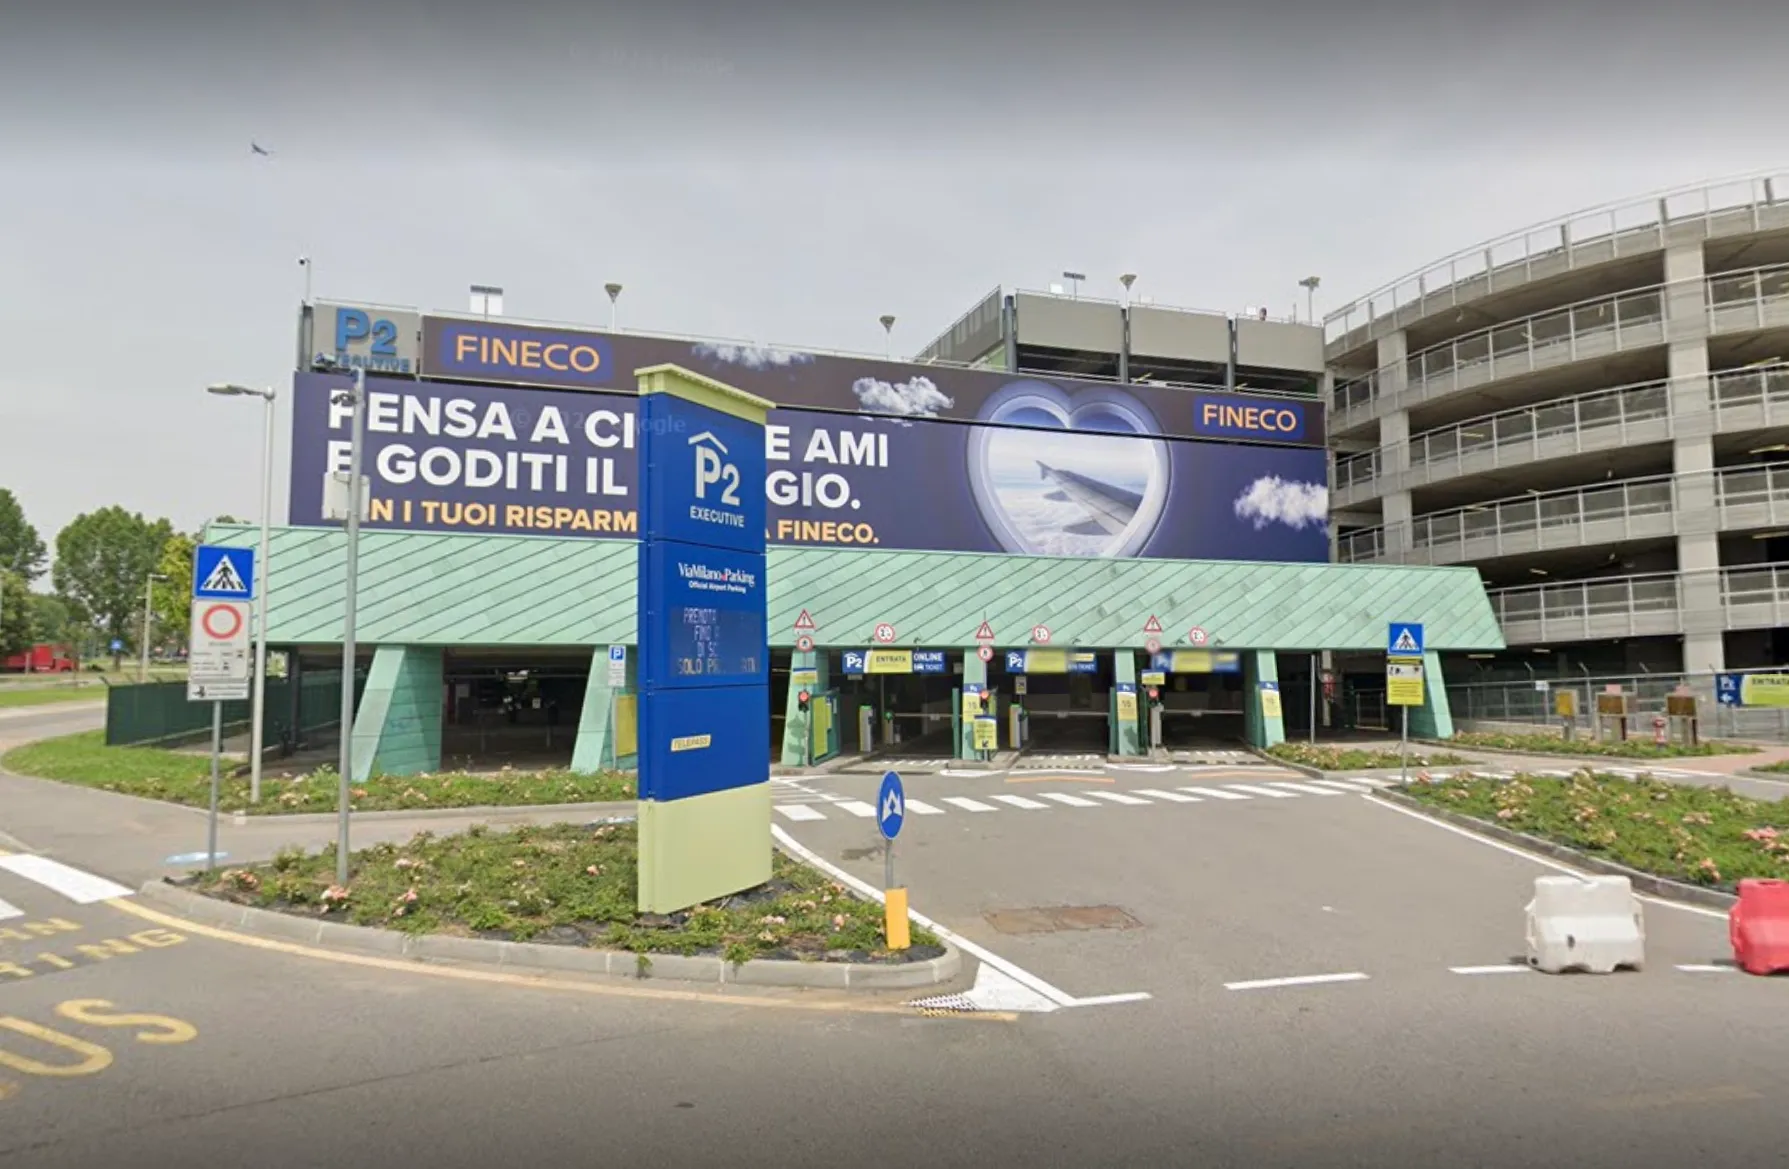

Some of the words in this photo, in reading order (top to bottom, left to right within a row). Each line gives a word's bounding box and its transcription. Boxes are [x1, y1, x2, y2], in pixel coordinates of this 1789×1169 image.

[336, 307, 397, 354] P2
[456, 334, 600, 373] FINECO
[530, 406, 570, 445] A
[803, 428, 889, 468] AMI
[1203, 403, 1297, 433] FINECO
[376, 444, 568, 493] GODITI
[586, 457, 628, 496] IL
[695, 445, 741, 506] P2
[403, 500, 412, 523] I
[421, 500, 496, 526] TUOI
[777, 519, 880, 544] FINECO.
[690, 505, 745, 528] EXECUTIVE
[689, 580, 708, 590] Official
[709, 583, 726, 592] Airport
[728, 584, 747, 595] Parking
[846, 656, 863, 668] P2
[876, 655, 907, 663] ENTRATA
[913, 653, 943, 662] ONLINE
[1009, 656, 1023, 668] P2
